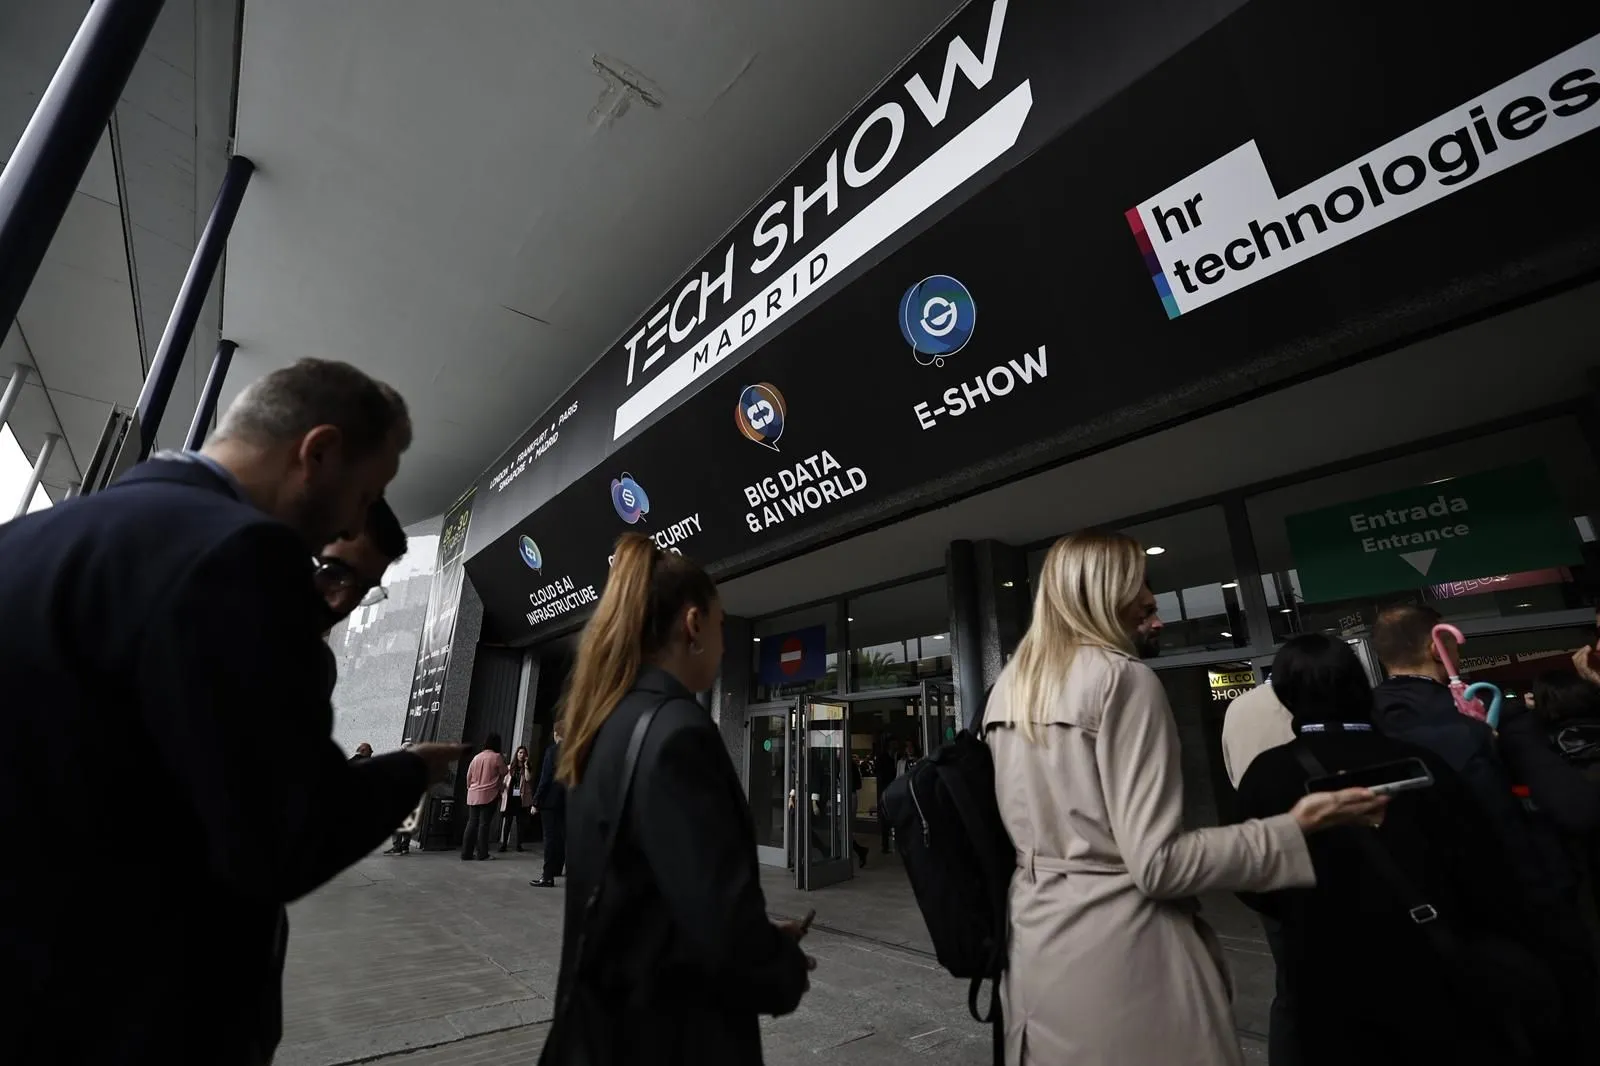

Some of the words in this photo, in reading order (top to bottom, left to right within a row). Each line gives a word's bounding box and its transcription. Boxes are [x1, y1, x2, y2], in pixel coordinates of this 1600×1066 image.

[624, 242, 734, 386] TECH
[749, 0, 1008, 275] SHOW
[1173, 67, 1600, 294] technologies
[1151, 192, 1204, 243] hr
[693, 253, 829, 373] MADRID
[913, 345, 1048, 430] E-SHOW
[489, 465, 510, 490] LONDON
[516, 428, 549, 464] FRANKFURT
[558, 400, 578, 426] PARIS
[498, 461, 526, 492] SINGAPORE
[535, 431, 559, 459] MADRID
[743, 476, 779, 508] BIG
[778, 450, 842, 487] DATA
[745, 512, 763, 534] &
[764, 501, 786, 528] AI
[785, 467, 868, 518] WORLD
[649, 513, 702, 550] CURITY
[1349, 494, 1469, 533] Entrada
[1361, 521, 1470, 553] Entrance
[526, 585, 598, 625] INFRASTRUCTURE
[529, 581, 557, 607] CLOUD
[556, 580, 566, 594] &
[564, 575, 574, 591] AI
[1460, 653, 1508, 669] echnologies
